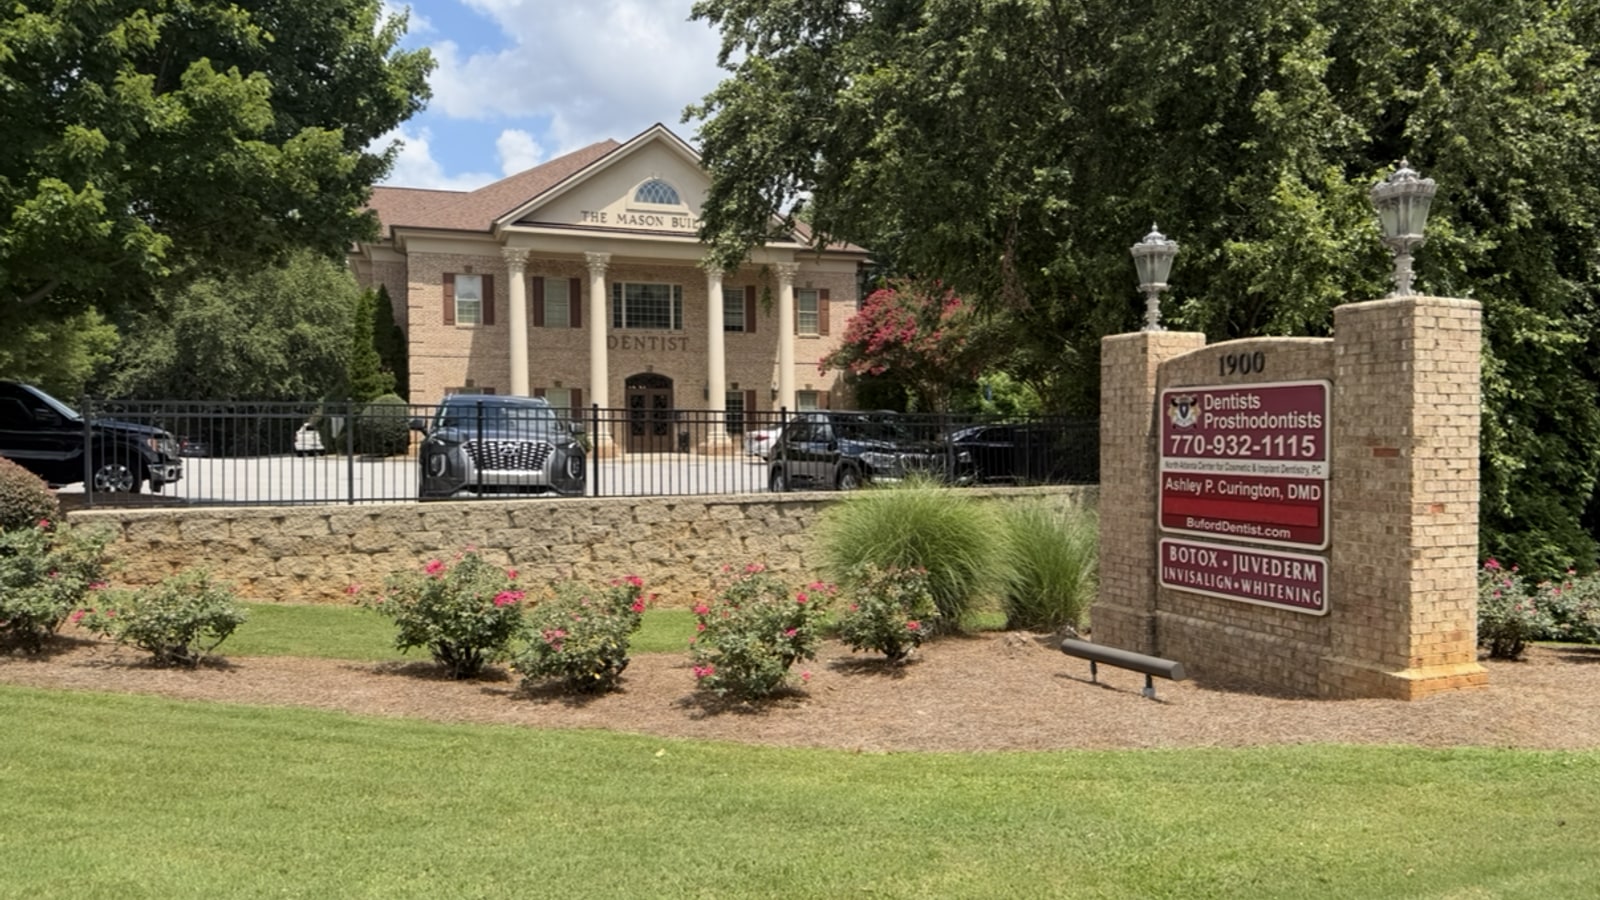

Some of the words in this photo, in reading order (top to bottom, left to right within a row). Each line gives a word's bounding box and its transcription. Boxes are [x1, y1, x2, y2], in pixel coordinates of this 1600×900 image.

[581, 210, 607, 224] THE
[616, 213, 664, 227] MASON
[672, 216, 699, 229] BUIL
[607, 335, 689, 351] DENTIST
[1218, 351, 1266, 377] 1900
[1204, 393, 1261, 410] Dentists
[1204, 411, 1322, 430] Prosthodontists
[1170, 434, 1316, 457] 770-932-1115
[1198, 461, 1215, 471] Center
[1225, 462, 1251, 473] Cosmetic
[1165, 477, 1202, 496] Ashley
[1205, 479, 1215, 494] P.
[1217, 480, 1284, 500] Curington,
[1288, 484, 1321, 500] DMD
[1186, 516, 1291, 539] BufordDentist.com
[1169, 545, 1218, 568] BOTOX
[1232, 553, 1317, 583] JUVEDERM
[1164, 566, 1232, 591] INVISALIGN
[1241, 578, 1322, 606] WHITENING
